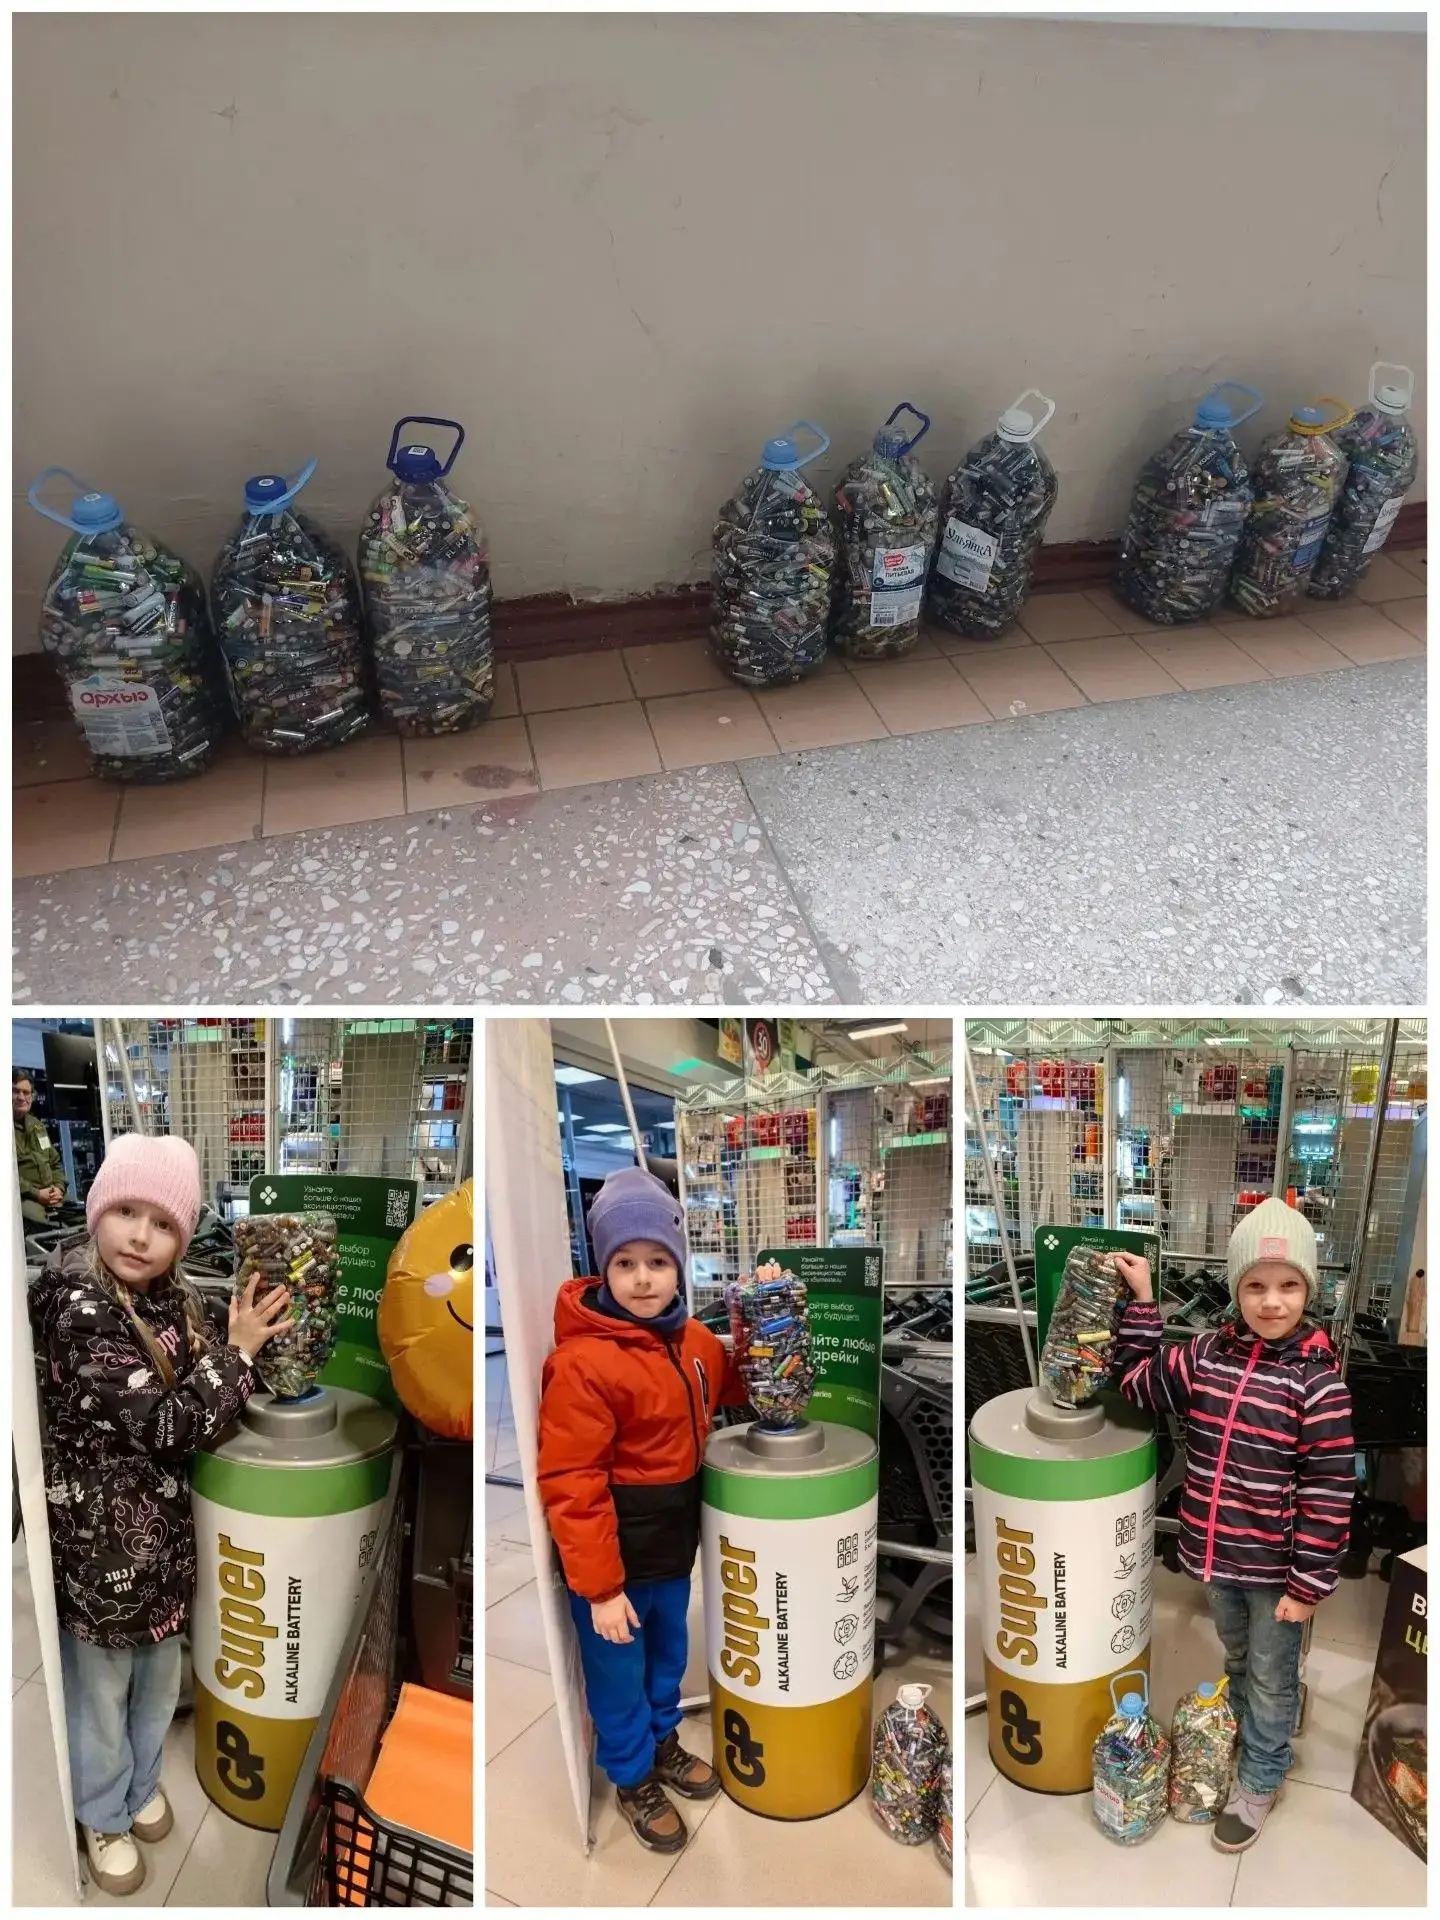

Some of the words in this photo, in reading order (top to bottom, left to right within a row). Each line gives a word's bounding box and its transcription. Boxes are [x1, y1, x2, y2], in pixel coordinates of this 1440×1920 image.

[303, 1194, 332, 1202] больше
[823, 1312, 860, 1321] будущего
[831, 1302, 854, 1311] выбор
[842, 1338, 876, 1353] любые
[286, 1576, 302, 1647] BATTERY
[719, 1535, 770, 1687] Super
[775, 1571, 788, 1632] BATTERY
[995, 1516, 1048, 1666] Super
[1053, 1552, 1066, 1611] BATTERY
[214, 1533, 279, 1699] Super
[1054, 1612, 1067, 1669] ALKALINE
[285, 1648, 300, 1704] ALKALINE
[776, 1633, 790, 1692] ALKALINE
[723, 1708, 766, 1788] GP
[1000, 1689, 1043, 1765] GP
[216, 1720, 266, 1801] GP
